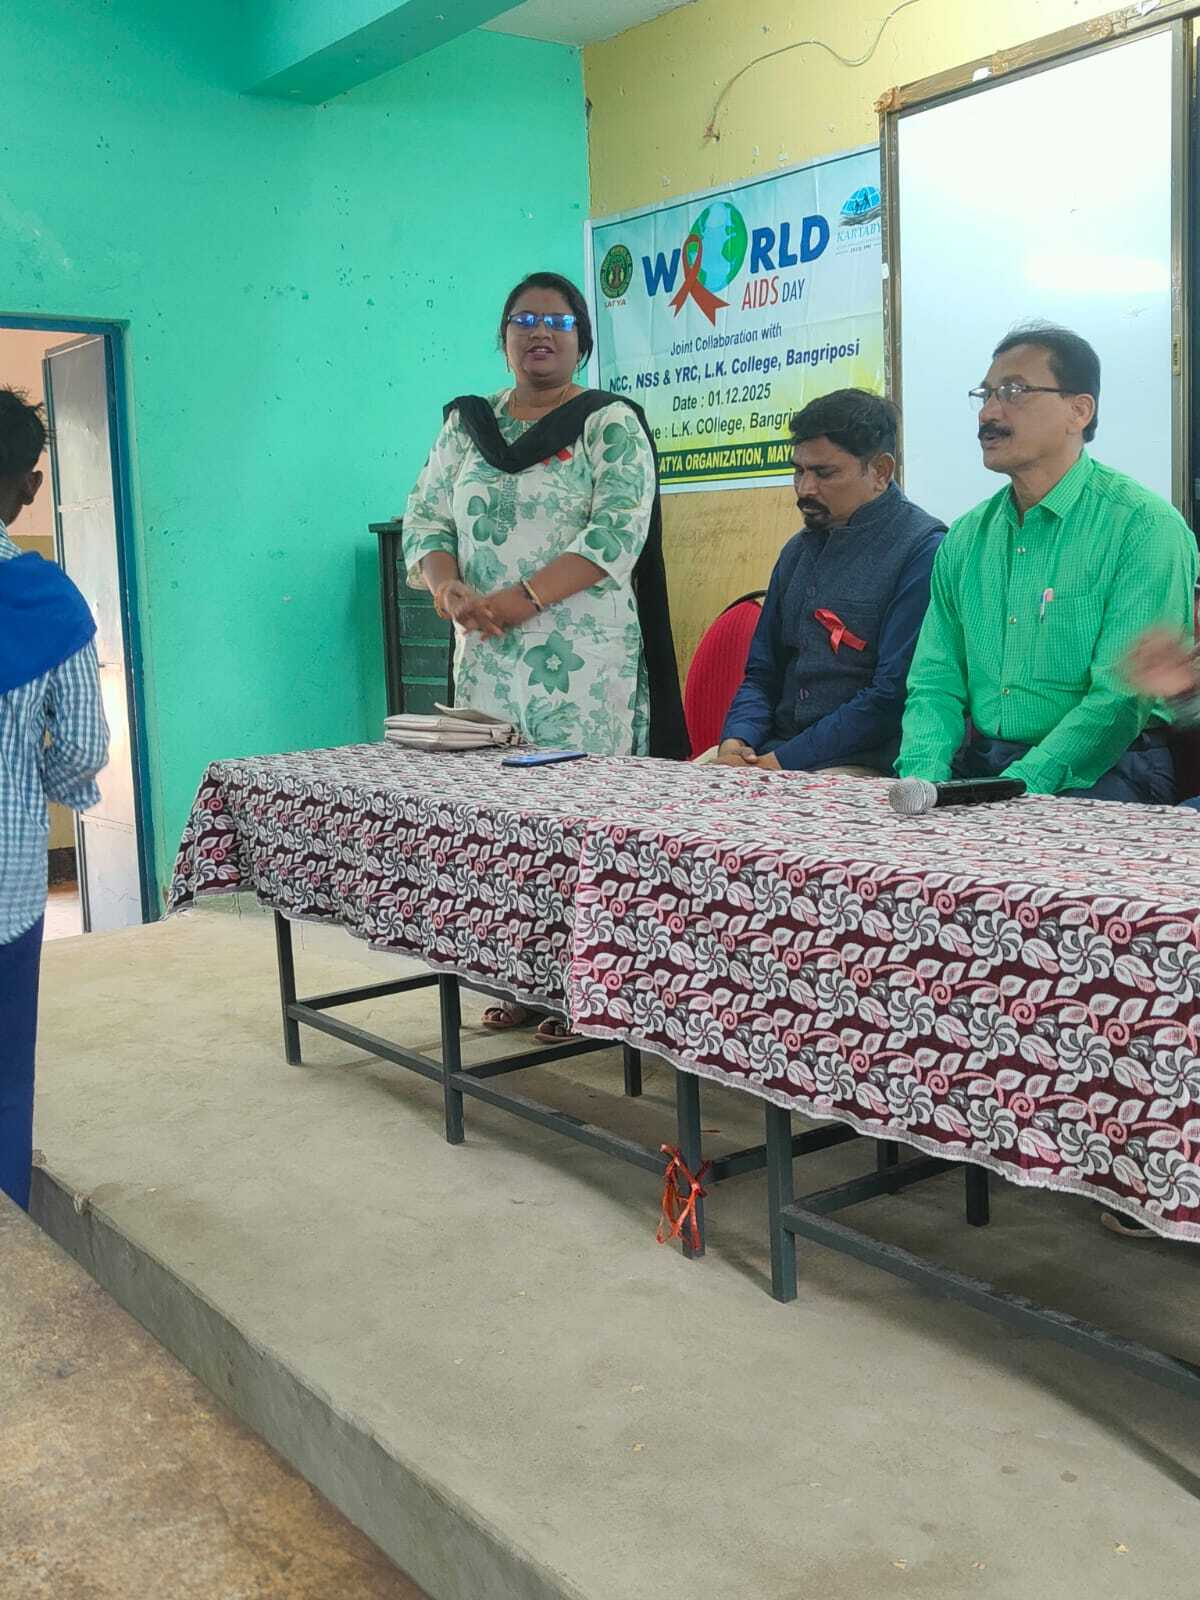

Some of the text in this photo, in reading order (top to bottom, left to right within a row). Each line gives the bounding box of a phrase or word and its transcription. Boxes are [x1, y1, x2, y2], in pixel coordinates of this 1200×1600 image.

[642, 201, 830, 297] WORLD
[741, 275, 806, 311] AIDS DAY
[670, 322, 782, 356] Joint Collaboration with
[609, 338, 860, 393] NCC, NSS & YRC, L.K. College, Bangriposi
[672, 395, 697, 412] Date
[708, 382, 772, 407] 01.12.2025
[671, 420, 693, 438] L.K.
[750, 407, 796, 431] Bangri
[685, 446, 764, 471] ORGANIZATION,
